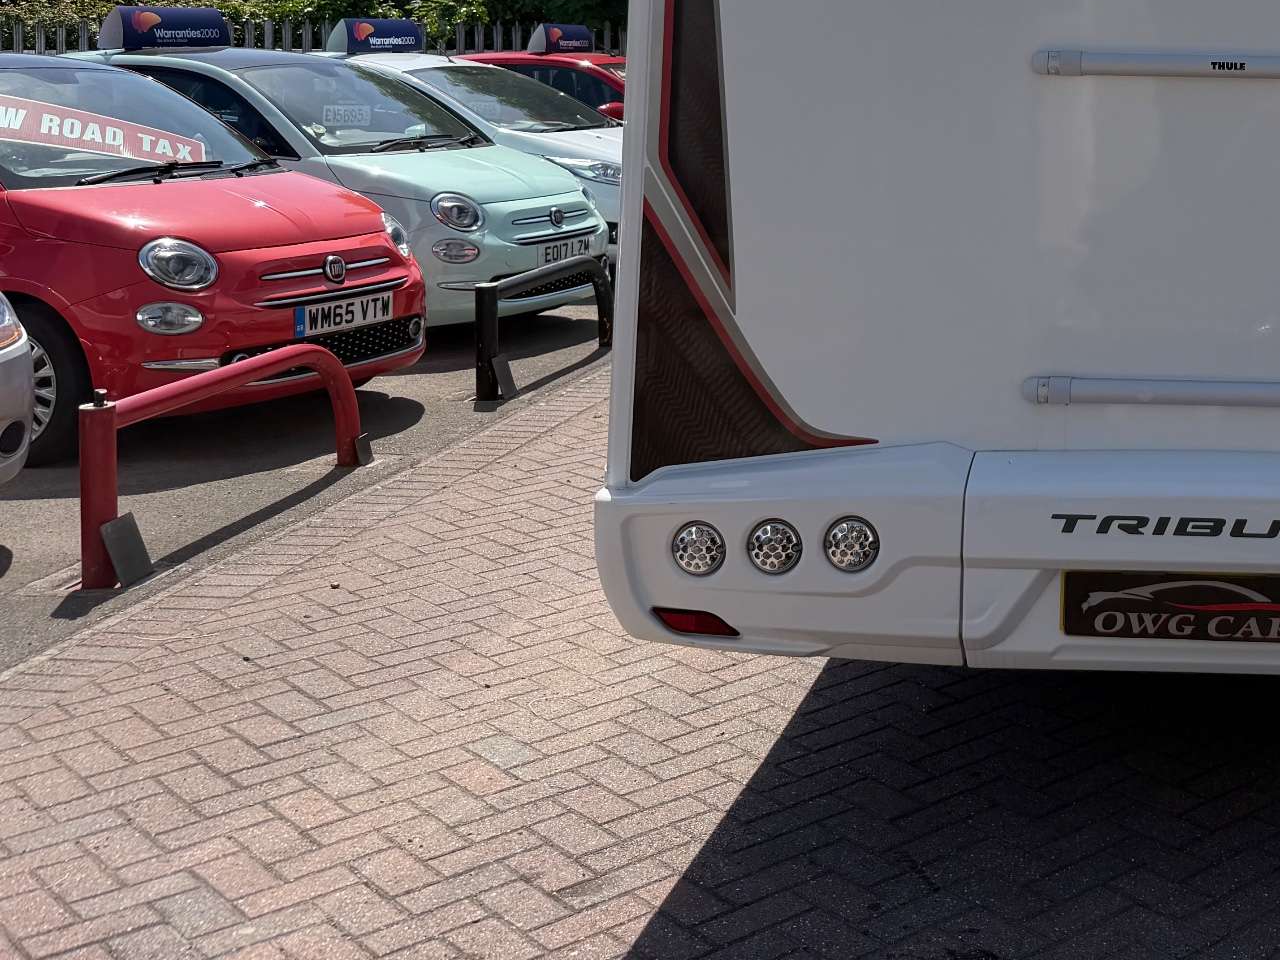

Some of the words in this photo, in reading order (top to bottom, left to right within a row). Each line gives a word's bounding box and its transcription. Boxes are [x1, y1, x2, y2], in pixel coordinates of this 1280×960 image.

[153, 28, 220, 38] Warranties2000
[1210, 61, 1246, 71] THULE
[40, 113, 124, 147] ROAD
[137, 133, 193, 162] TAX
[308, 302, 355, 331] WM65
[360, 295, 391, 321] VTW
[1093, 611, 1197, 637] OWG
